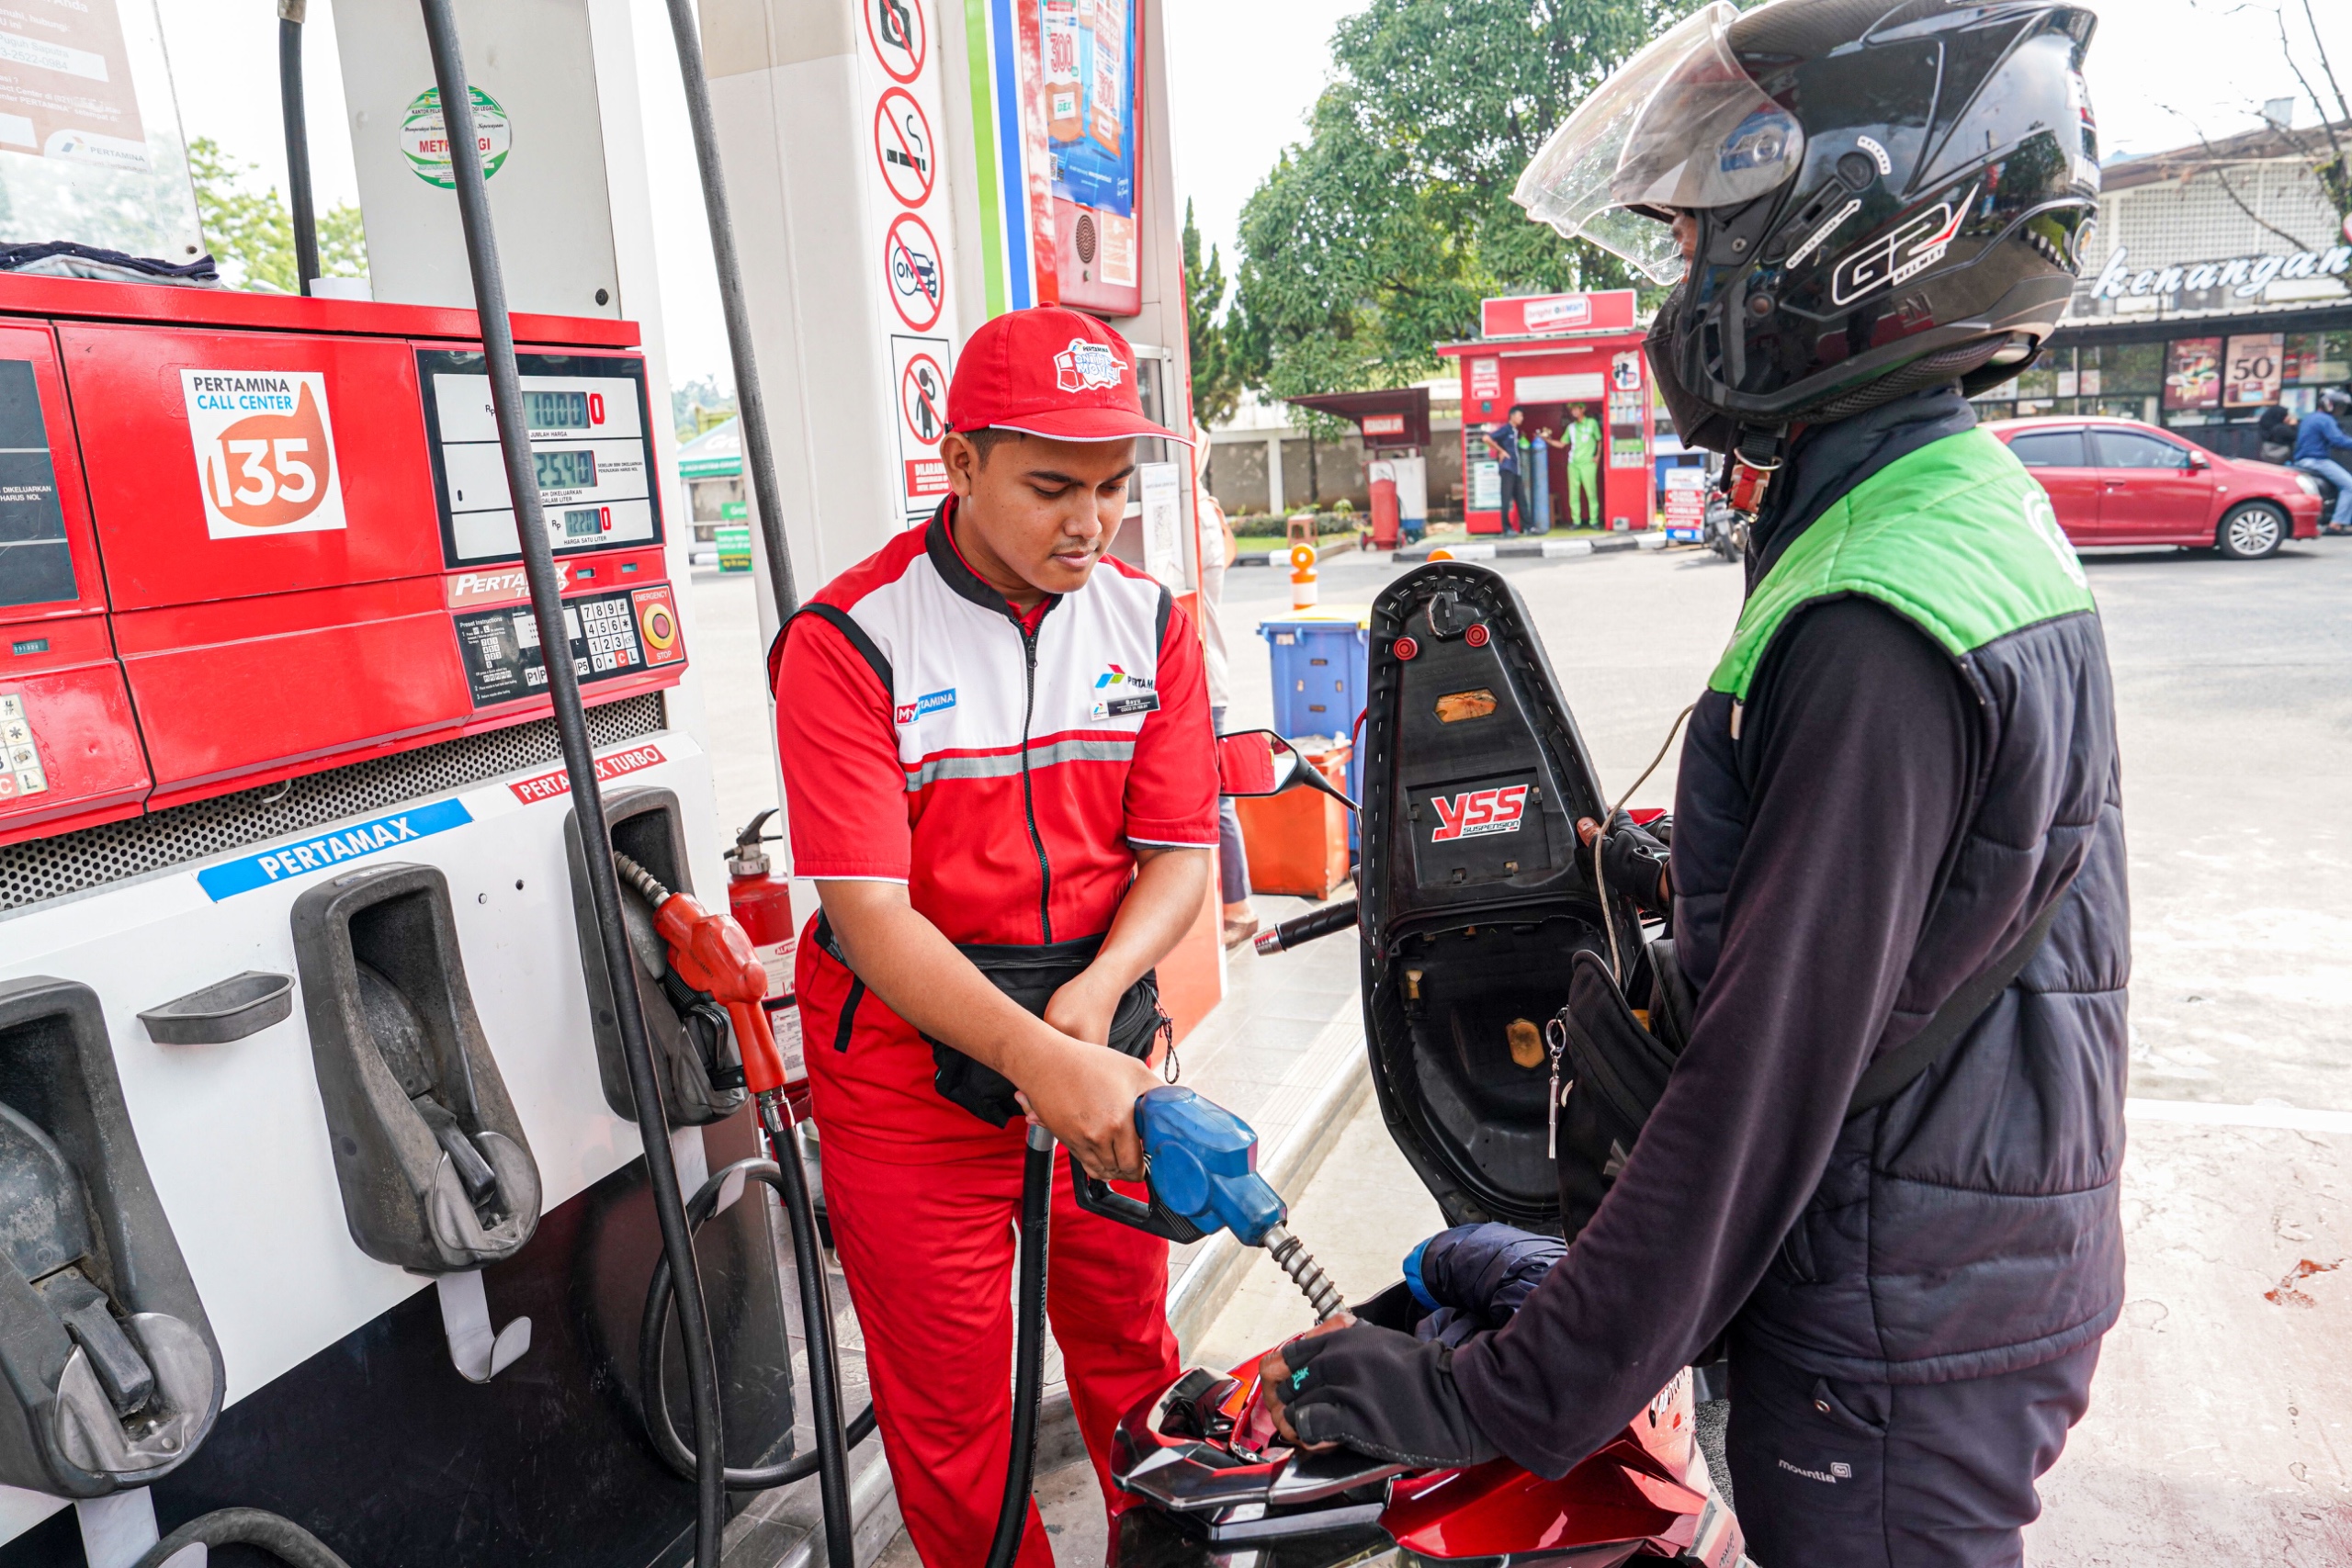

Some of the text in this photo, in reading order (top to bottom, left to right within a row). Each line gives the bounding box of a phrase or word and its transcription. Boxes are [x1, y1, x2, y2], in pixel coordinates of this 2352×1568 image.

[9, 19, 22, 30] ini
[1050, 33, 1073, 73] 300
[1057, 102, 1071, 112] DEX
[419, 138, 491, 152] METGI
[90, 146, 145, 163] PERTAMINA
[897, 262, 915, 279] ON
[1895, 246, 1943, 281] HELMET
[2090, 245, 2352, 299] kenangan
[2233, 356, 2274, 380] 50
[194, 377, 289, 392] PERTAMINA
[198, 395, 293, 411] CALL CENTER
[216, 437, 316, 508] 135
[552, 520, 560, 530] Rp
[455, 565, 569, 596] PERTAX
[635, 591, 667, 603] EMERGENCY
[583, 607, 590, 618] 7
[596, 605, 603, 616] 8
[608, 604, 615, 615] 9
[460, 616, 503, 628] Preset Instructions
[589, 620, 618, 635] 4 5 6
[593, 637, 622, 652] 1 2 3
[596, 651, 637, 669] 0 C L
[656, 650, 672, 660] STOP
[527, 671, 538, 682] P1
[577, 662, 588, 671] P5
[518, 748, 659, 800] PERTAX TURBO
[1432, 785, 1527, 841] YSS
[1464, 820, 1519, 833] SUSPENSION
[258, 817, 419, 879] PERTAMAX
[1779, 1459, 1837, 1483] mountia
